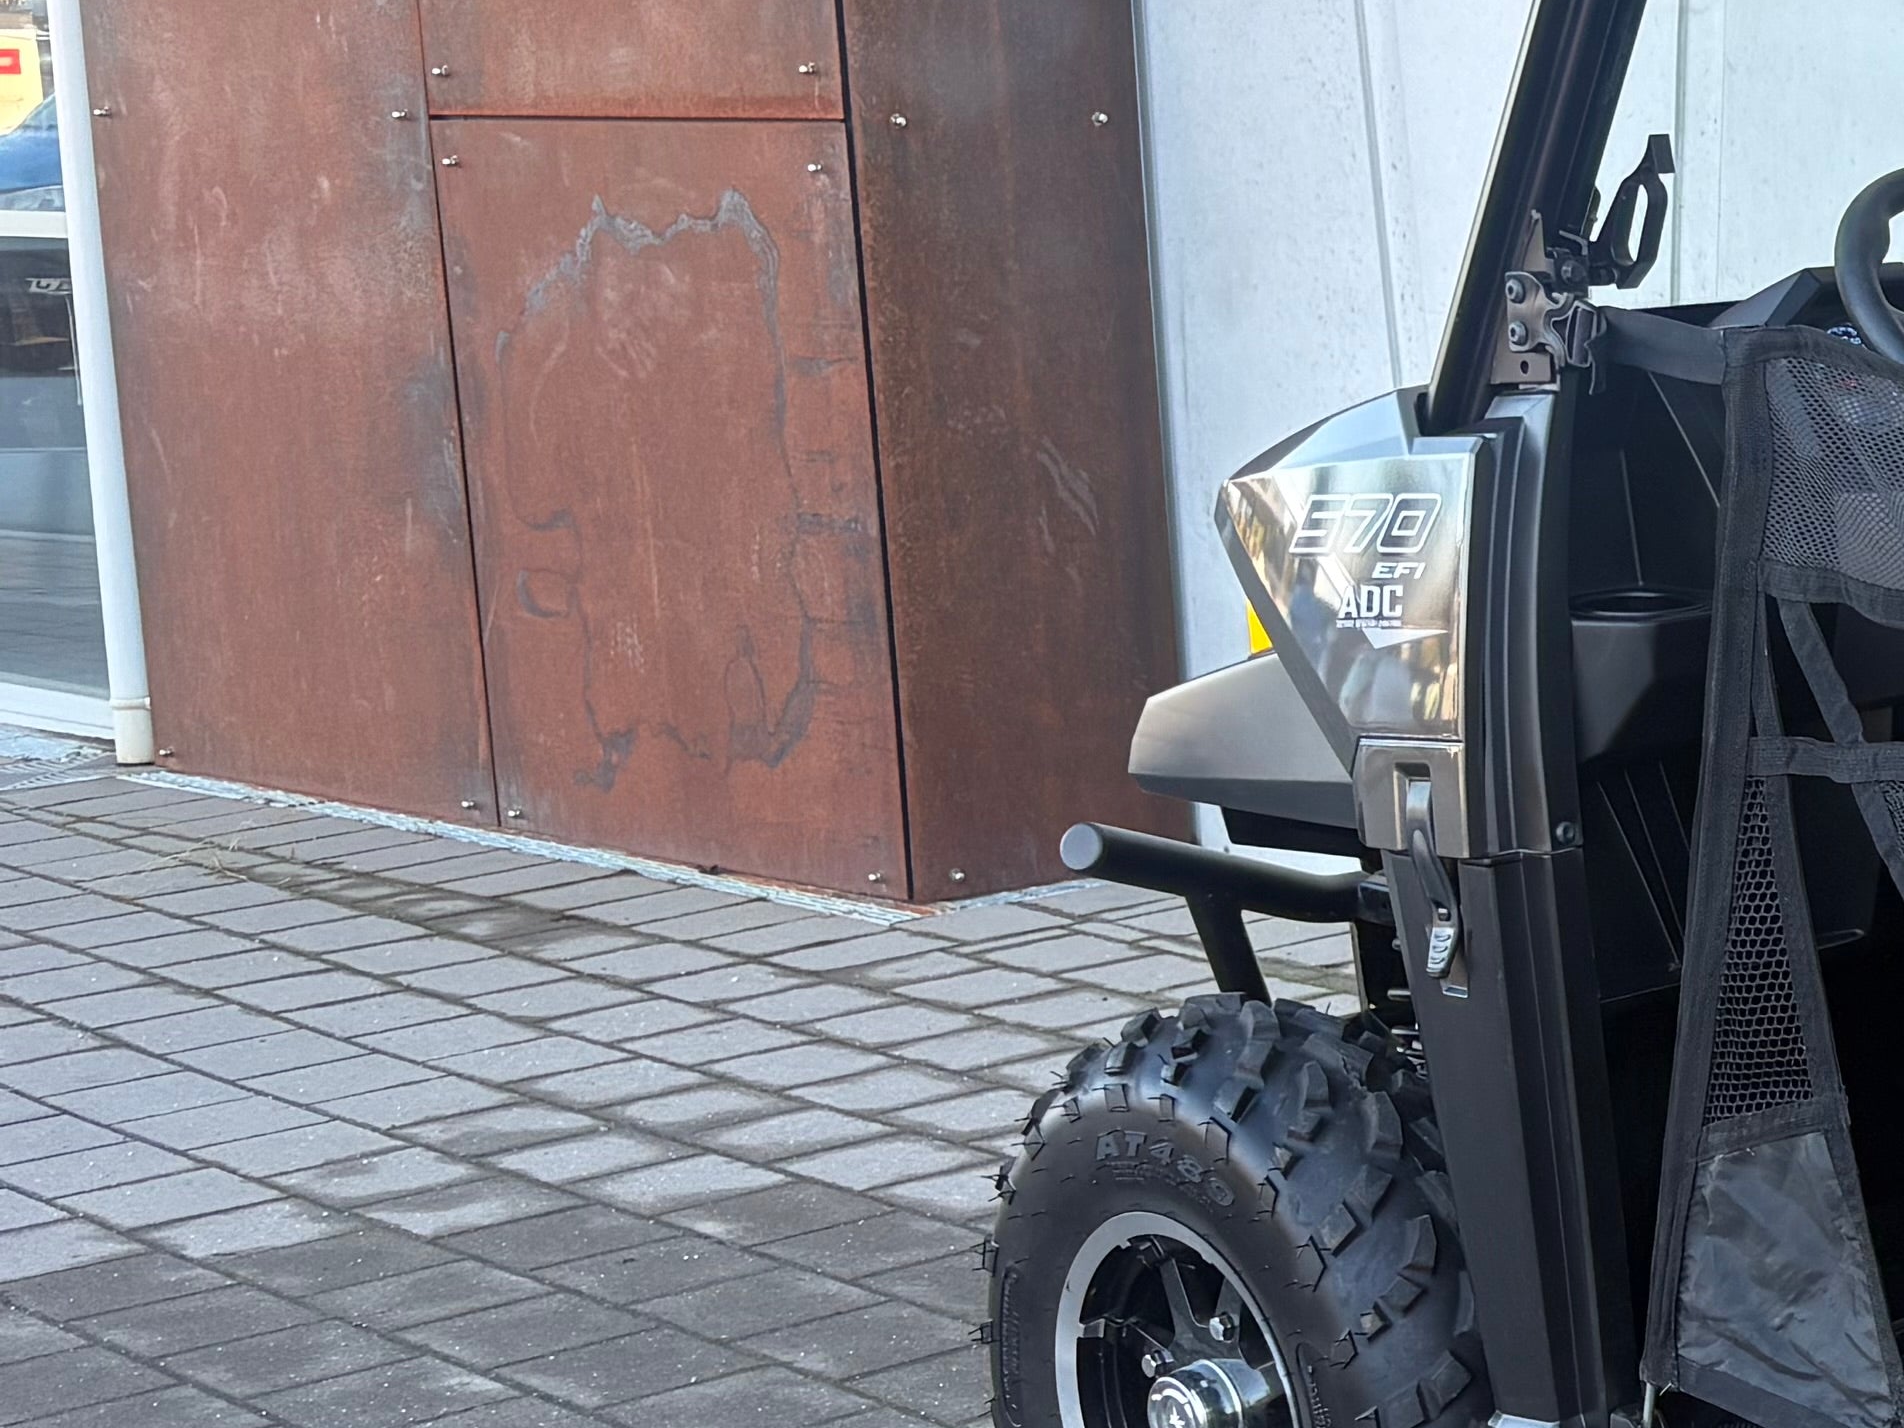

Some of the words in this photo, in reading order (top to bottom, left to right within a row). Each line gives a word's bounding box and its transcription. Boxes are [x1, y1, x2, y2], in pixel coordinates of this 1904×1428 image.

[1288, 492, 1442, 554] 570
[1372, 561, 1426, 580] EFI
[1337, 584, 1404, 619] ADC
